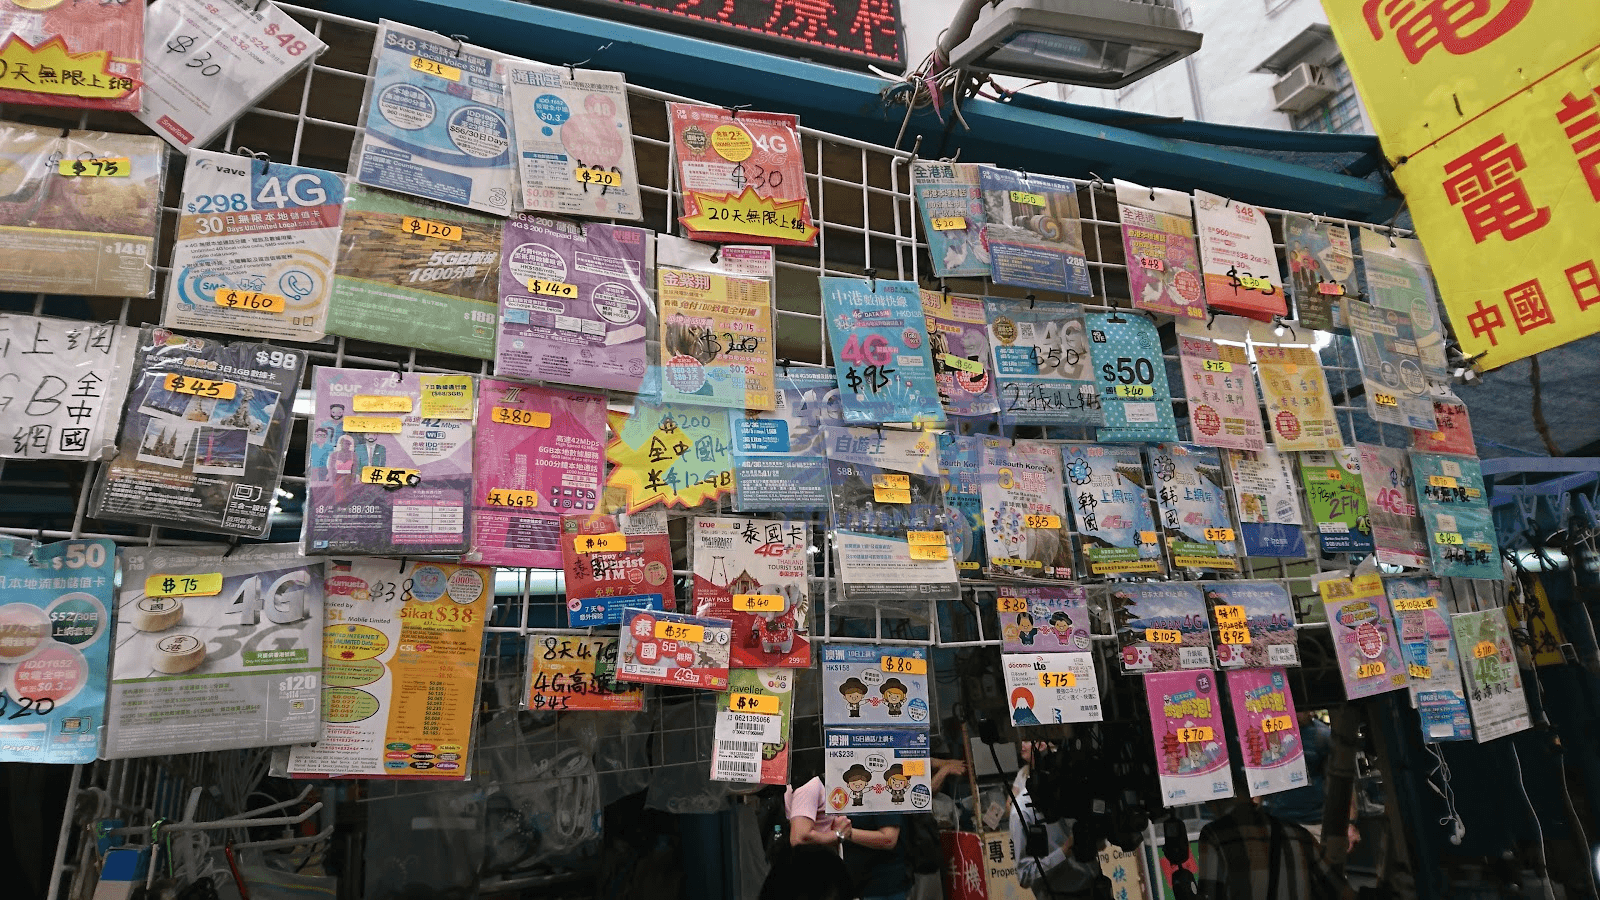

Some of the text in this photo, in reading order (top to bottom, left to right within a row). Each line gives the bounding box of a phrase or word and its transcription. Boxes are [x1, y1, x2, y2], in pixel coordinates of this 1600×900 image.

[263, 23, 307, 56] $48
[386, 32, 417, 52] $48
[166, 35, 221, 76] $30
[417, 49, 487, 75] Local Voice SIM
[413, 57, 443, 75] $25
[512, 69, 562, 89] 通訊王
[487, 135, 509, 147] Days
[756, 135, 788, 154] 4G
[755, 150, 788, 166] 3G
[71, 159, 119, 177] $75
[216, 165, 246, 177] vave
[731, 161, 783, 190] $30
[914, 165, 955, 179] 全港通
[582, 170, 612, 187] $20
[257, 173, 327, 208] 4G
[187, 194, 248, 214] $298
[1235, 204, 1254, 217] $48
[195, 210, 321, 235] 30 日無限本地儲值卡
[226, 221, 297, 234] Days Unlimited Local
[411, 219, 452, 237] $120
[544, 228, 572, 240] Prepaid
[573, 235, 588, 243] SIM
[105, 241, 147, 257] $148
[1140, 256, 1160, 270] $48
[532, 279, 572, 295] $140
[663, 271, 711, 291] 金紫荊
[226, 292, 273, 309] $160
[463, 309, 496, 325] $188
[1467, 278, 1555, 346] 中國
[840, 333, 893, 367] 4G
[1029, 344, 1081, 368] $50
[255, 350, 297, 371] $98
[1206, 361, 1225, 371] $75
[845, 365, 896, 393] $95
[1103, 357, 1155, 385] $50
[1193, 372, 1215, 386] 中國
[170, 375, 224, 396] $45
[1123, 386, 1144, 397] $40
[59, 370, 103, 452] 全中國
[499, 408, 532, 425] $80
[1003, 460, 1024, 469] South
[998, 467, 1015, 490] 8
[506, 495, 535, 507] 6GB
[1376, 487, 1416, 518] 4G LTE
[225, 520, 262, 531] Starter Pack
[699, 521, 716, 529] true
[1027, 516, 1049, 528] $85
[741, 520, 803, 545] 泰國卡
[1206, 528, 1227, 541] $75
[52, 543, 107, 571] $50
[161, 577, 199, 593] $75
[368, 578, 414, 603] $38
[224, 569, 314, 626] 4G
[745, 597, 769, 609] $40
[400, 606, 473, 624] Sikat $38
[1183, 613, 1203, 629] 4G
[1271, 613, 1289, 628] 4G
[664, 624, 691, 639] $35
[1152, 631, 1177, 643] $105
[1223, 631, 1245, 644] $95
[400, 644, 416, 652] CSL
[662, 641, 677, 652] 5日
[825, 649, 845, 661] 澳洲
[825, 664, 850, 672] HK$158
[886, 657, 912, 672] $80
[1359, 664, 1381, 676] $180
[674, 667, 693, 682] 4G
[1042, 672, 1069, 687] $75
[279, 674, 317, 692] $120
[729, 685, 764, 695] raveller
[1265, 719, 1284, 732] $60
[828, 734, 849, 747] 澳洲
[1183, 729, 1205, 741] $70
